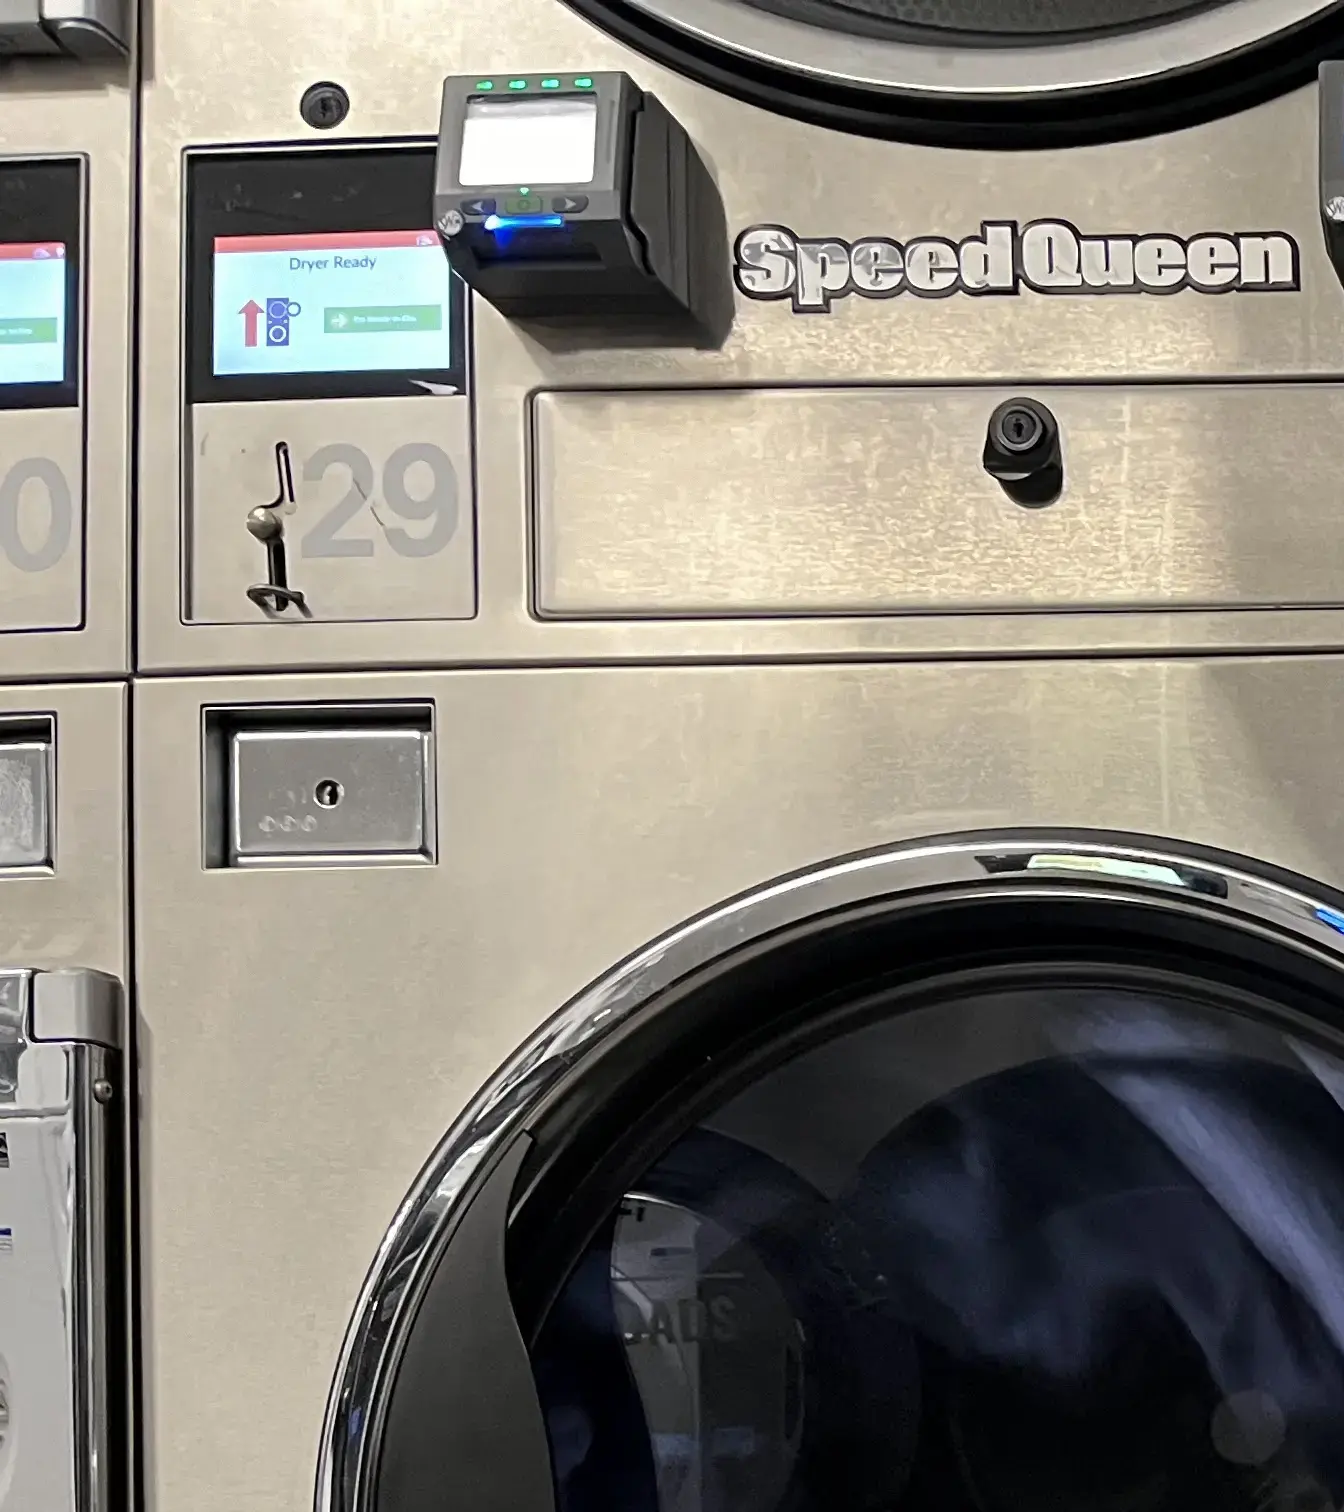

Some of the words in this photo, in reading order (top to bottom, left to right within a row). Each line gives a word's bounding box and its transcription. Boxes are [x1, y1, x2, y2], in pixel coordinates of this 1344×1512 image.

[290, 257, 329, 273] Dryer
[334, 255, 377, 272] Ready
[302, 443, 459, 558] 29
